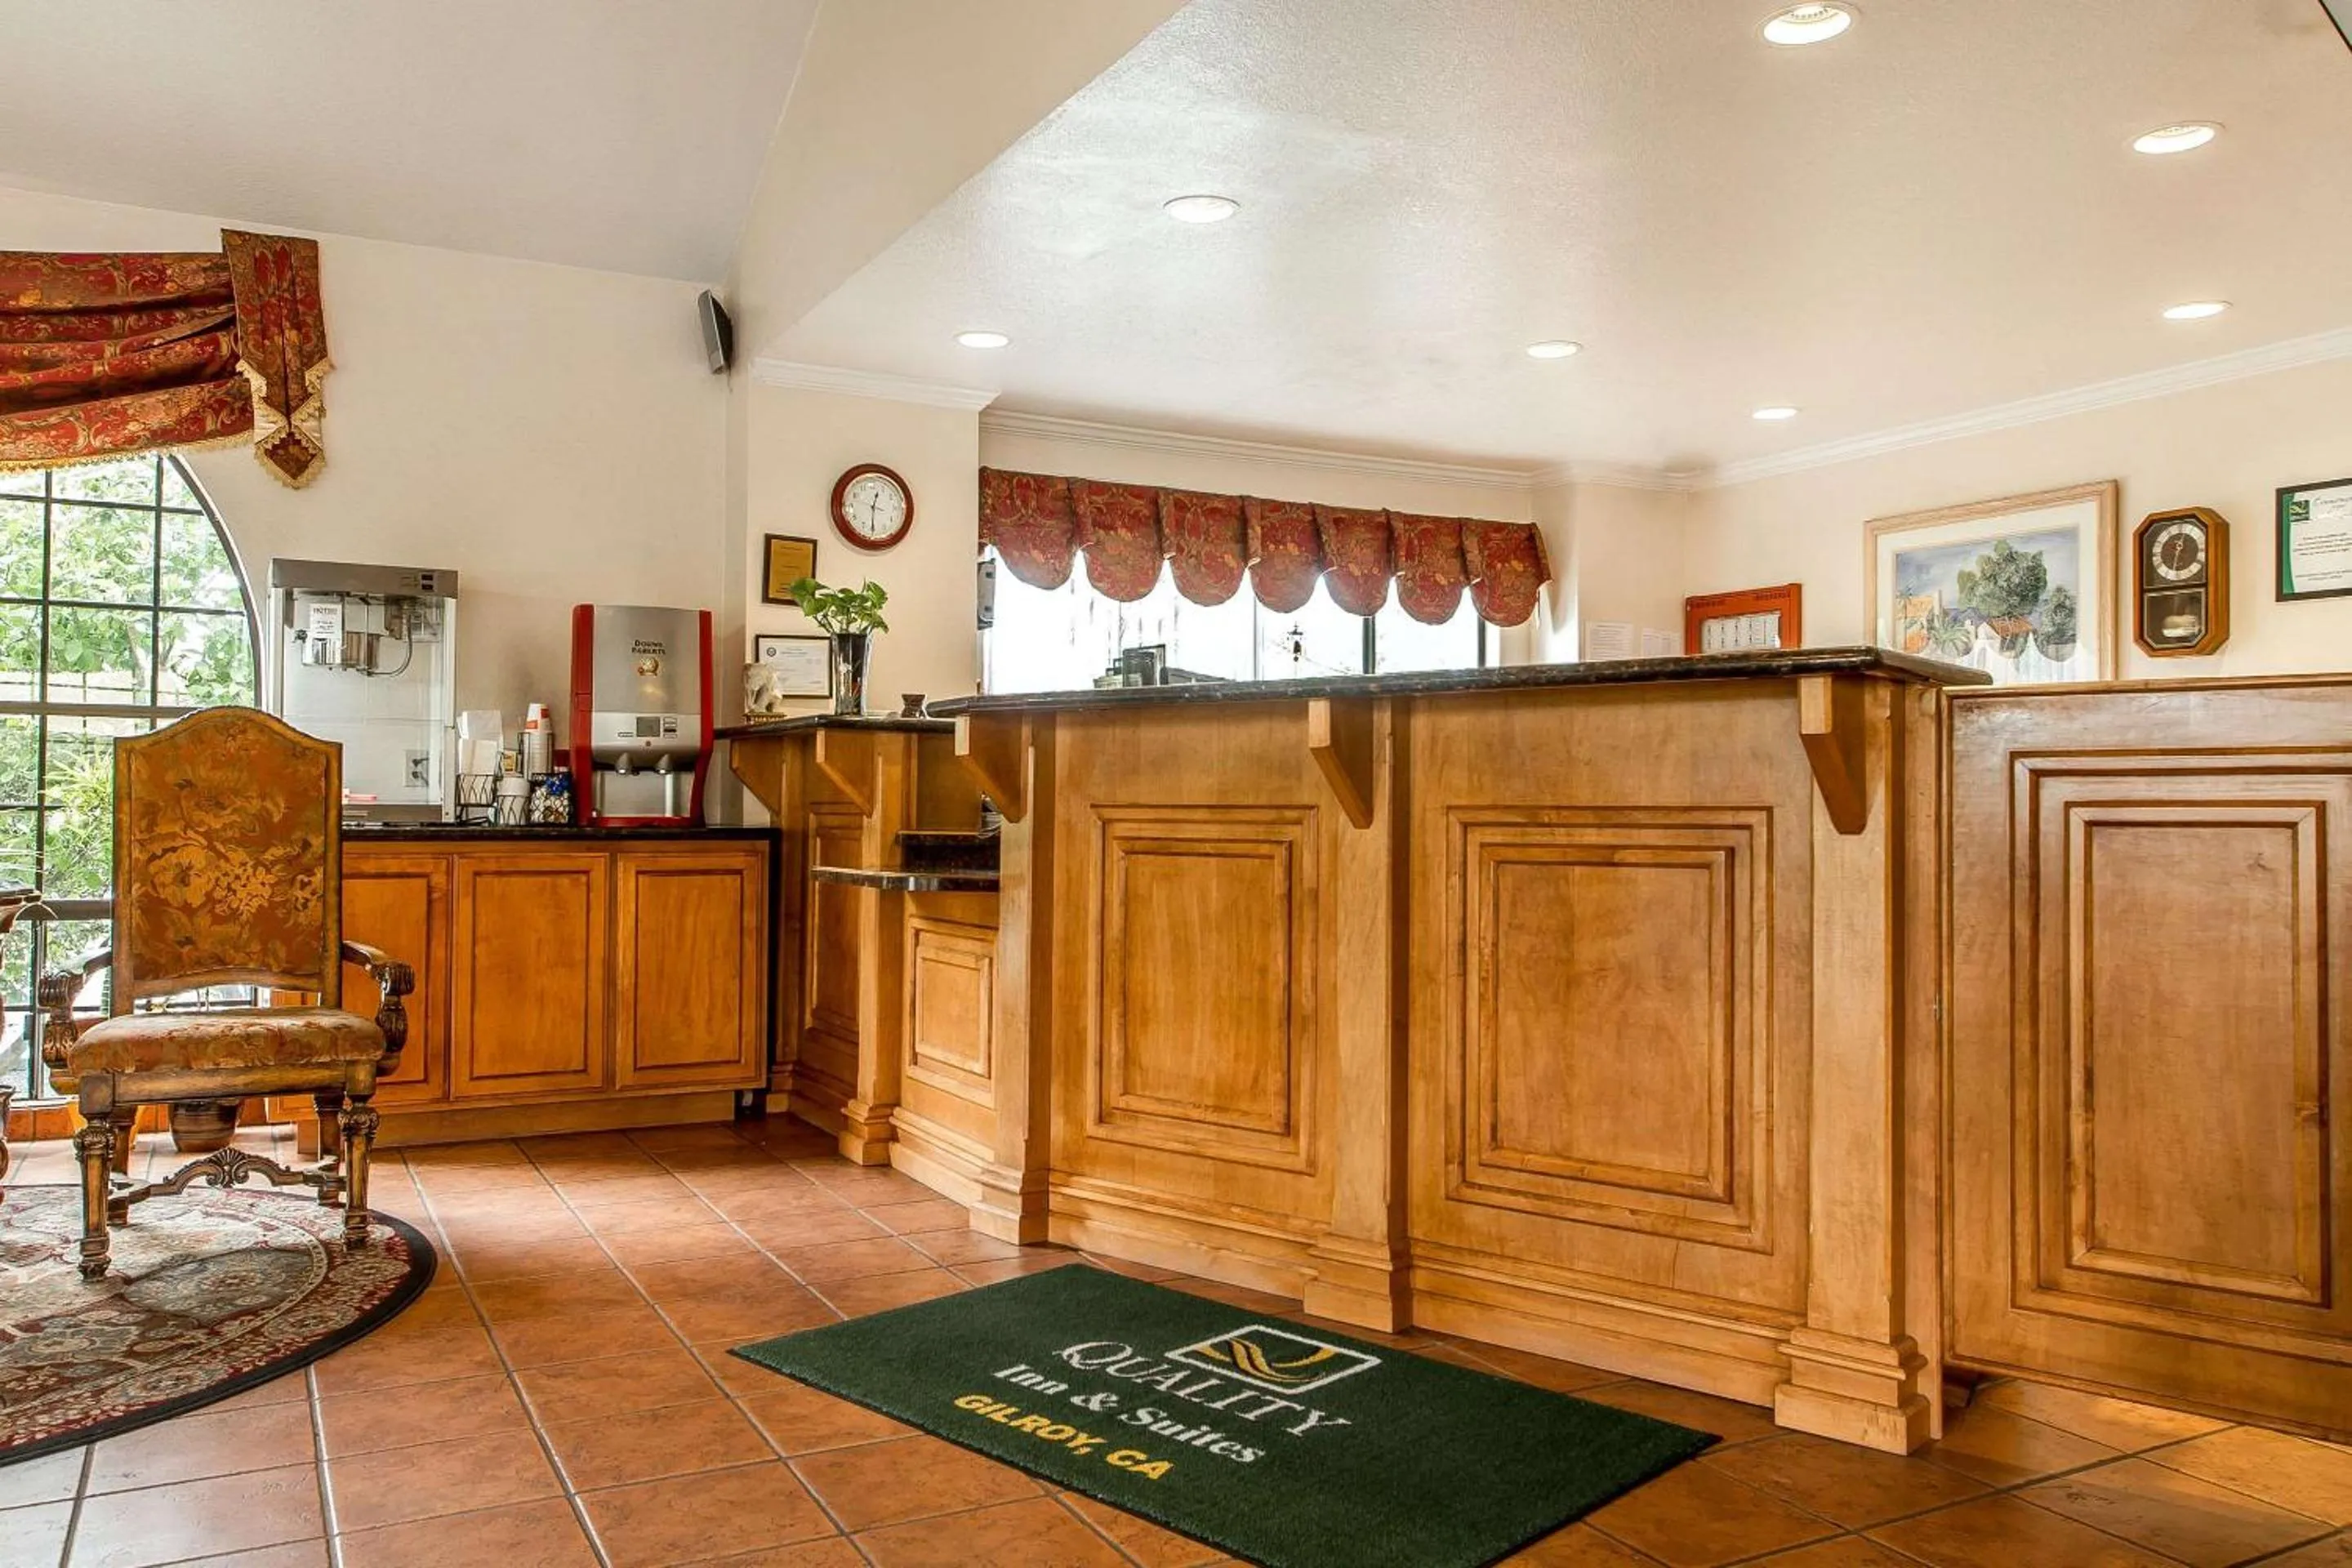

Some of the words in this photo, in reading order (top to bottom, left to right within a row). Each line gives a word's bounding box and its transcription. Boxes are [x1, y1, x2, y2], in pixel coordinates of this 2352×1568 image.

[953, 1394, 1108, 1455] GILROY,
[1106, 1449, 1176, 1480] CA
[992, 1364, 1069, 1395] Inn
[1070, 1392, 1120, 1411] &
[1116, 1407, 1265, 1463] Suites
[1052, 1341, 1352, 1437] QUALITY
